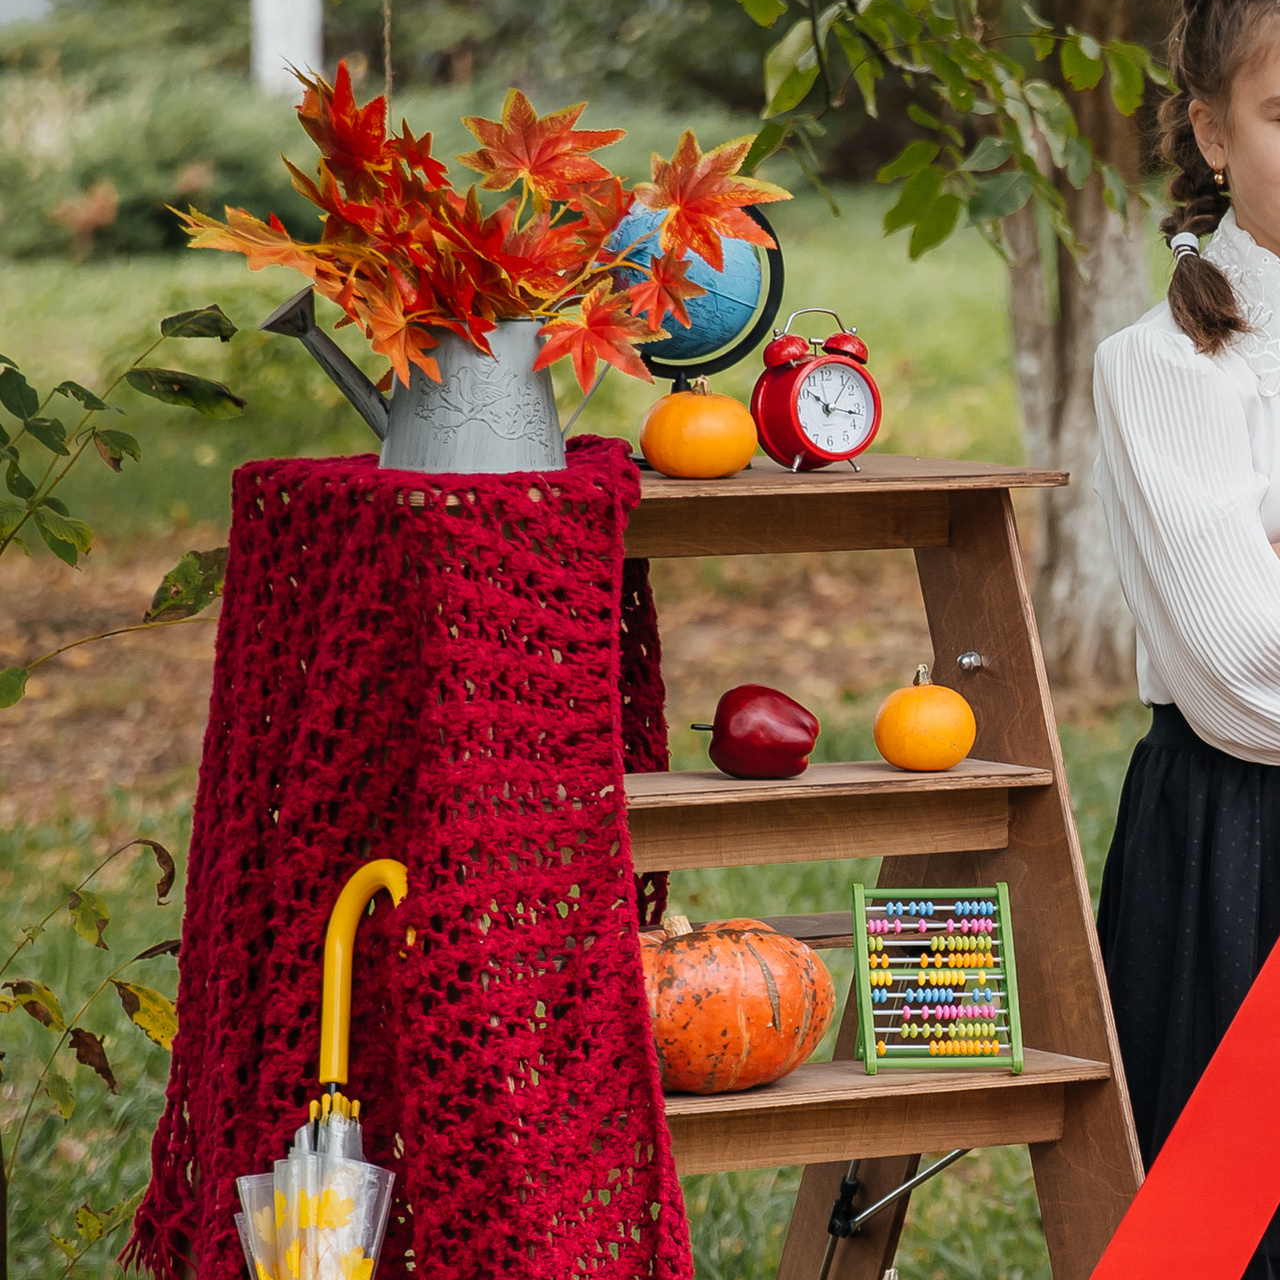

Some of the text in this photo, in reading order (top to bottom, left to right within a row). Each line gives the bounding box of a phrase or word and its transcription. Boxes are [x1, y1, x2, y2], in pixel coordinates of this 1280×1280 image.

[807, 375, 816, 387] 11
[820, 370, 832, 381] 12
[847, 385, 855, 396] 2
[854, 402, 860, 415] 3
[850, 418, 857, 430] 4
[813, 434, 819, 446] 7
[826, 435, 834, 447] 6
[842, 431, 849, 442] 5
